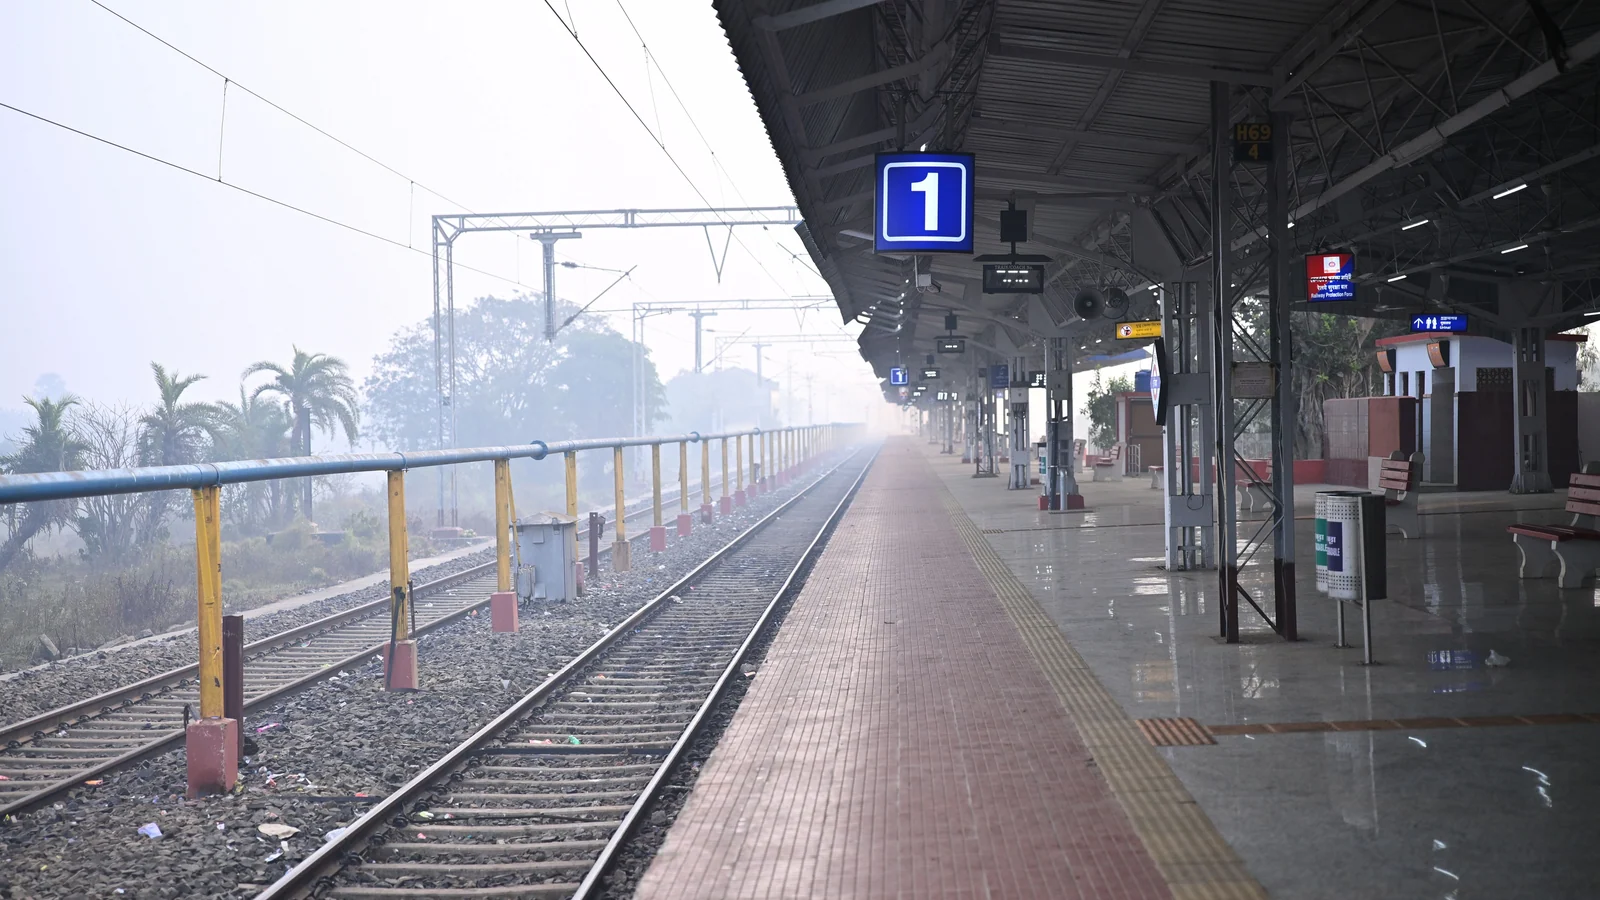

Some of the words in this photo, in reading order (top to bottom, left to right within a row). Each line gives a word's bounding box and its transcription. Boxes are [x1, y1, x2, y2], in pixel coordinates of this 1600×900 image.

[1237, 124, 1271, 140] H69
[1248, 143, 1258, 160] 4
[911, 172, 939, 231] 1
[896, 371, 903, 382] 1
